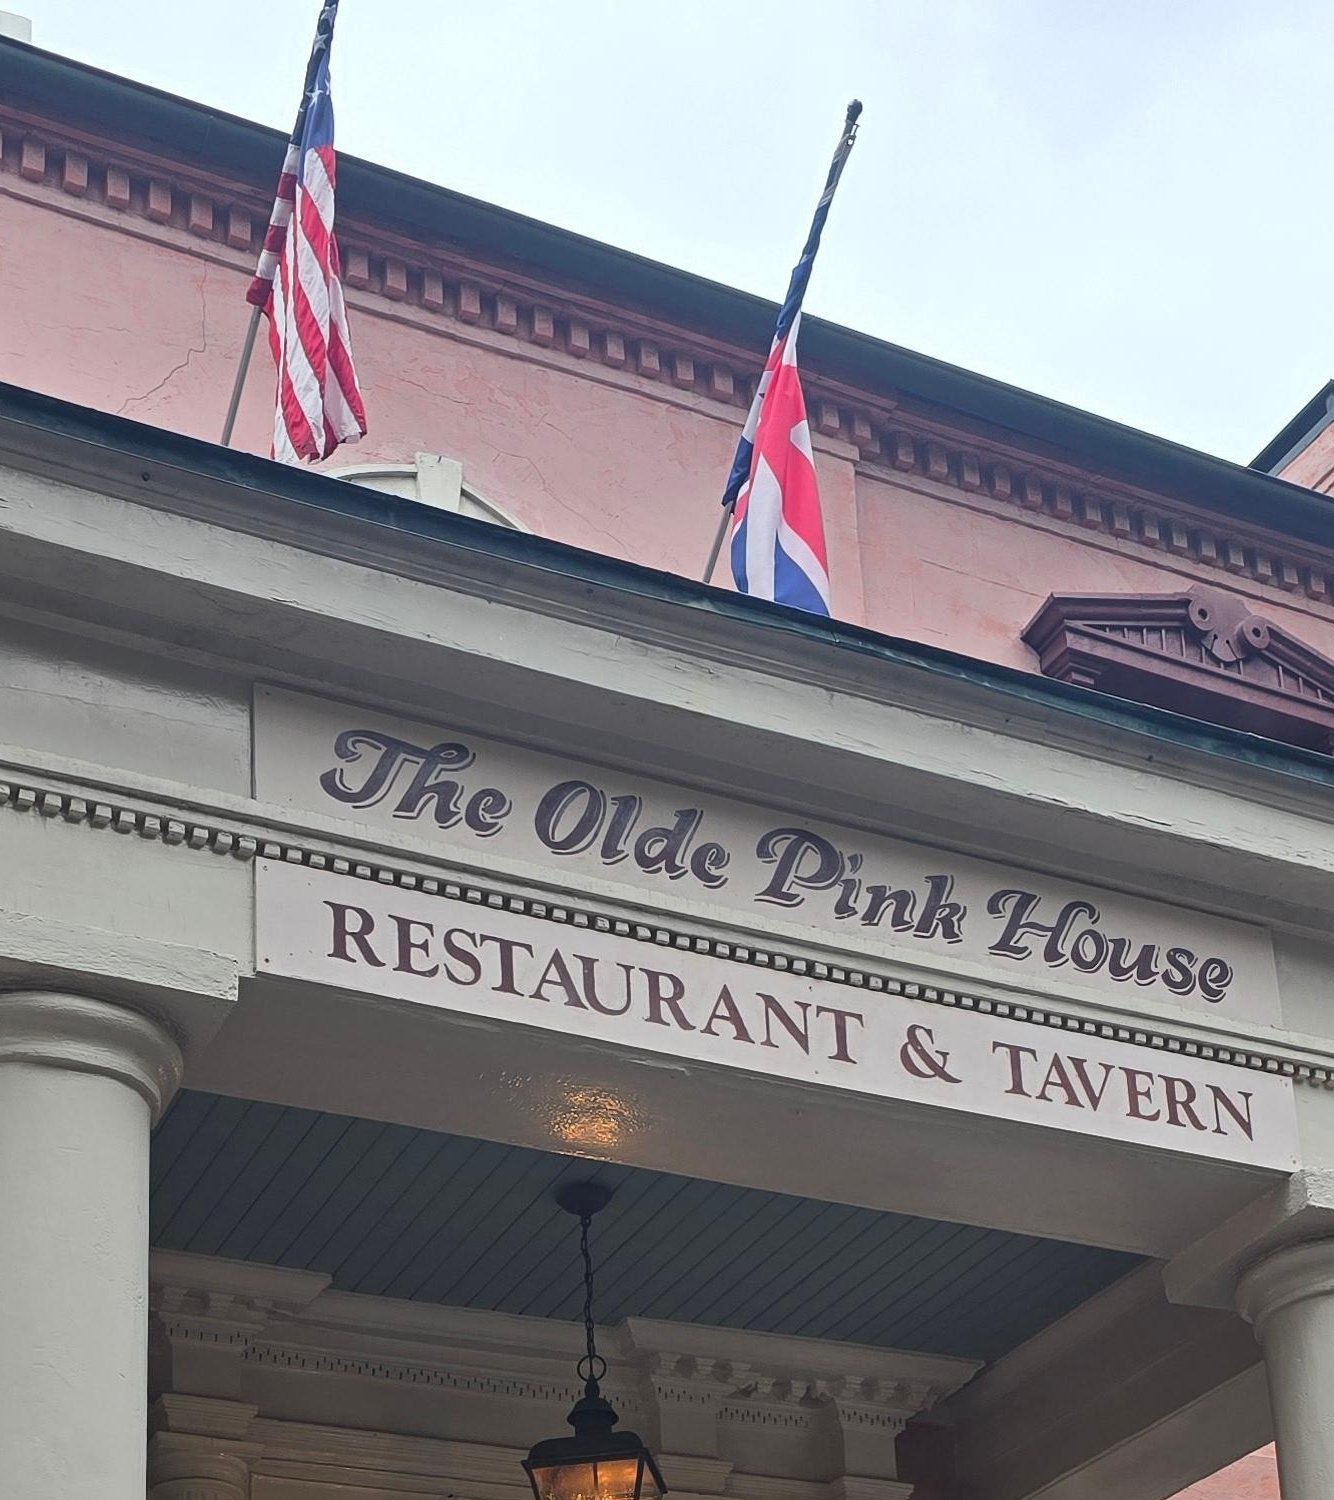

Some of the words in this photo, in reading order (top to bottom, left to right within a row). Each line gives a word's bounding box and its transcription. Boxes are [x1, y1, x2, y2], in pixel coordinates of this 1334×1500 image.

[319, 729, 513, 838] The
[534, 780, 731, 889] Olde
[754, 827, 968, 944] Pink
[986, 888, 1234, 1003] House
[323, 901, 865, 1065] RESTAURANT
[899, 1023, 963, 1084] &
[992, 1041, 1254, 1142] TAVERN
